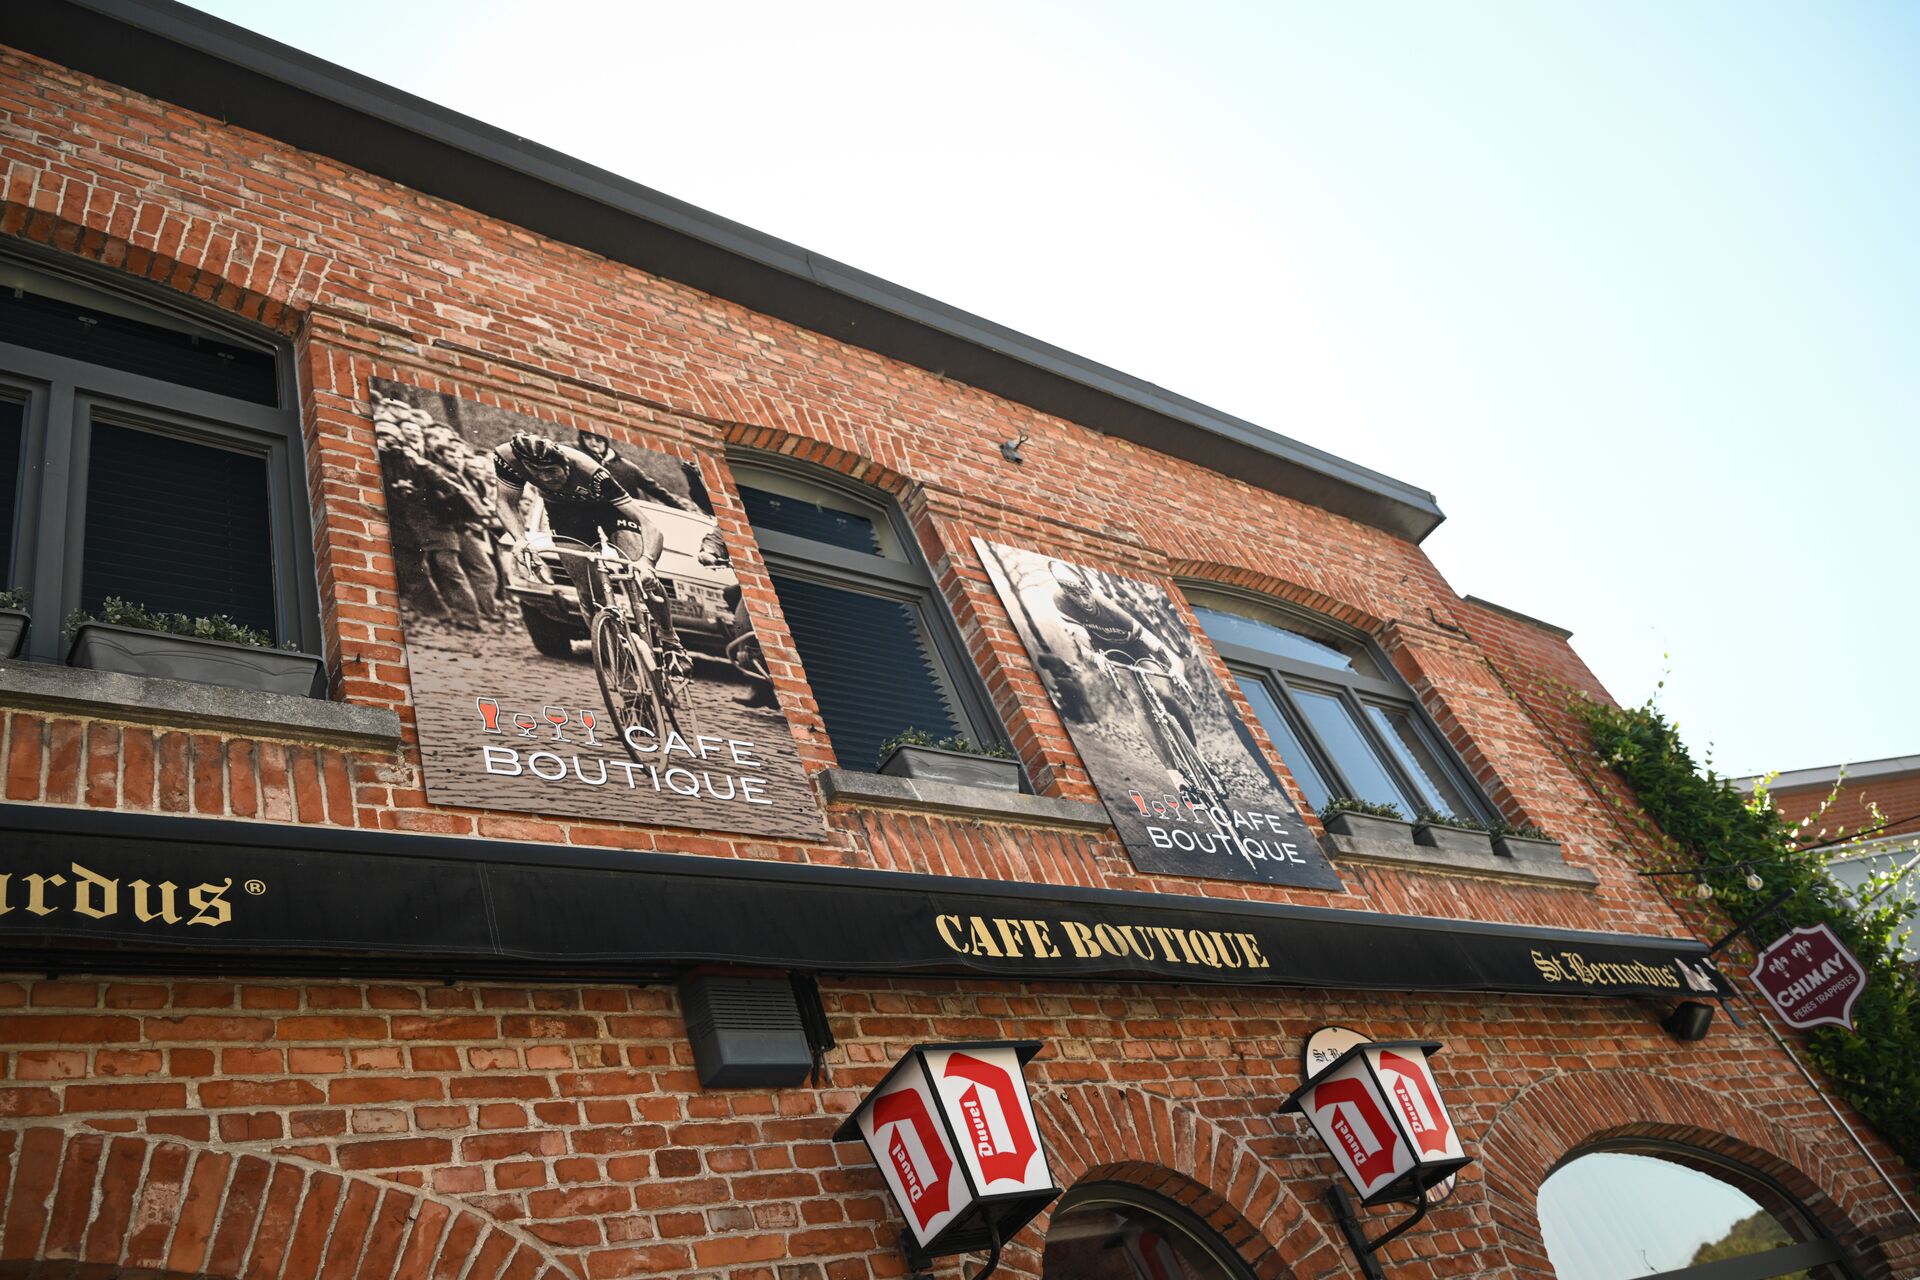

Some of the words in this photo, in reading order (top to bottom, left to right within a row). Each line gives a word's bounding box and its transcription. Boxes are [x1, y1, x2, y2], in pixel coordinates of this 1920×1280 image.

[624, 726, 761, 767] CAFE
[482, 745, 773, 805] BOUTIQUE
[1210, 806, 1289, 835] CAFE
[935, 914, 1062, 959] CAFE
[1060, 921, 1270, 969] BOUTIQUE
[1776, 952, 1844, 1008] CHIMAY
[963, 1100, 993, 1158] Duvel
[1396, 1088, 1424, 1133] Duvel
[1335, 1119, 1367, 1166] Duvel
[892, 1143, 923, 1203] Duvel
